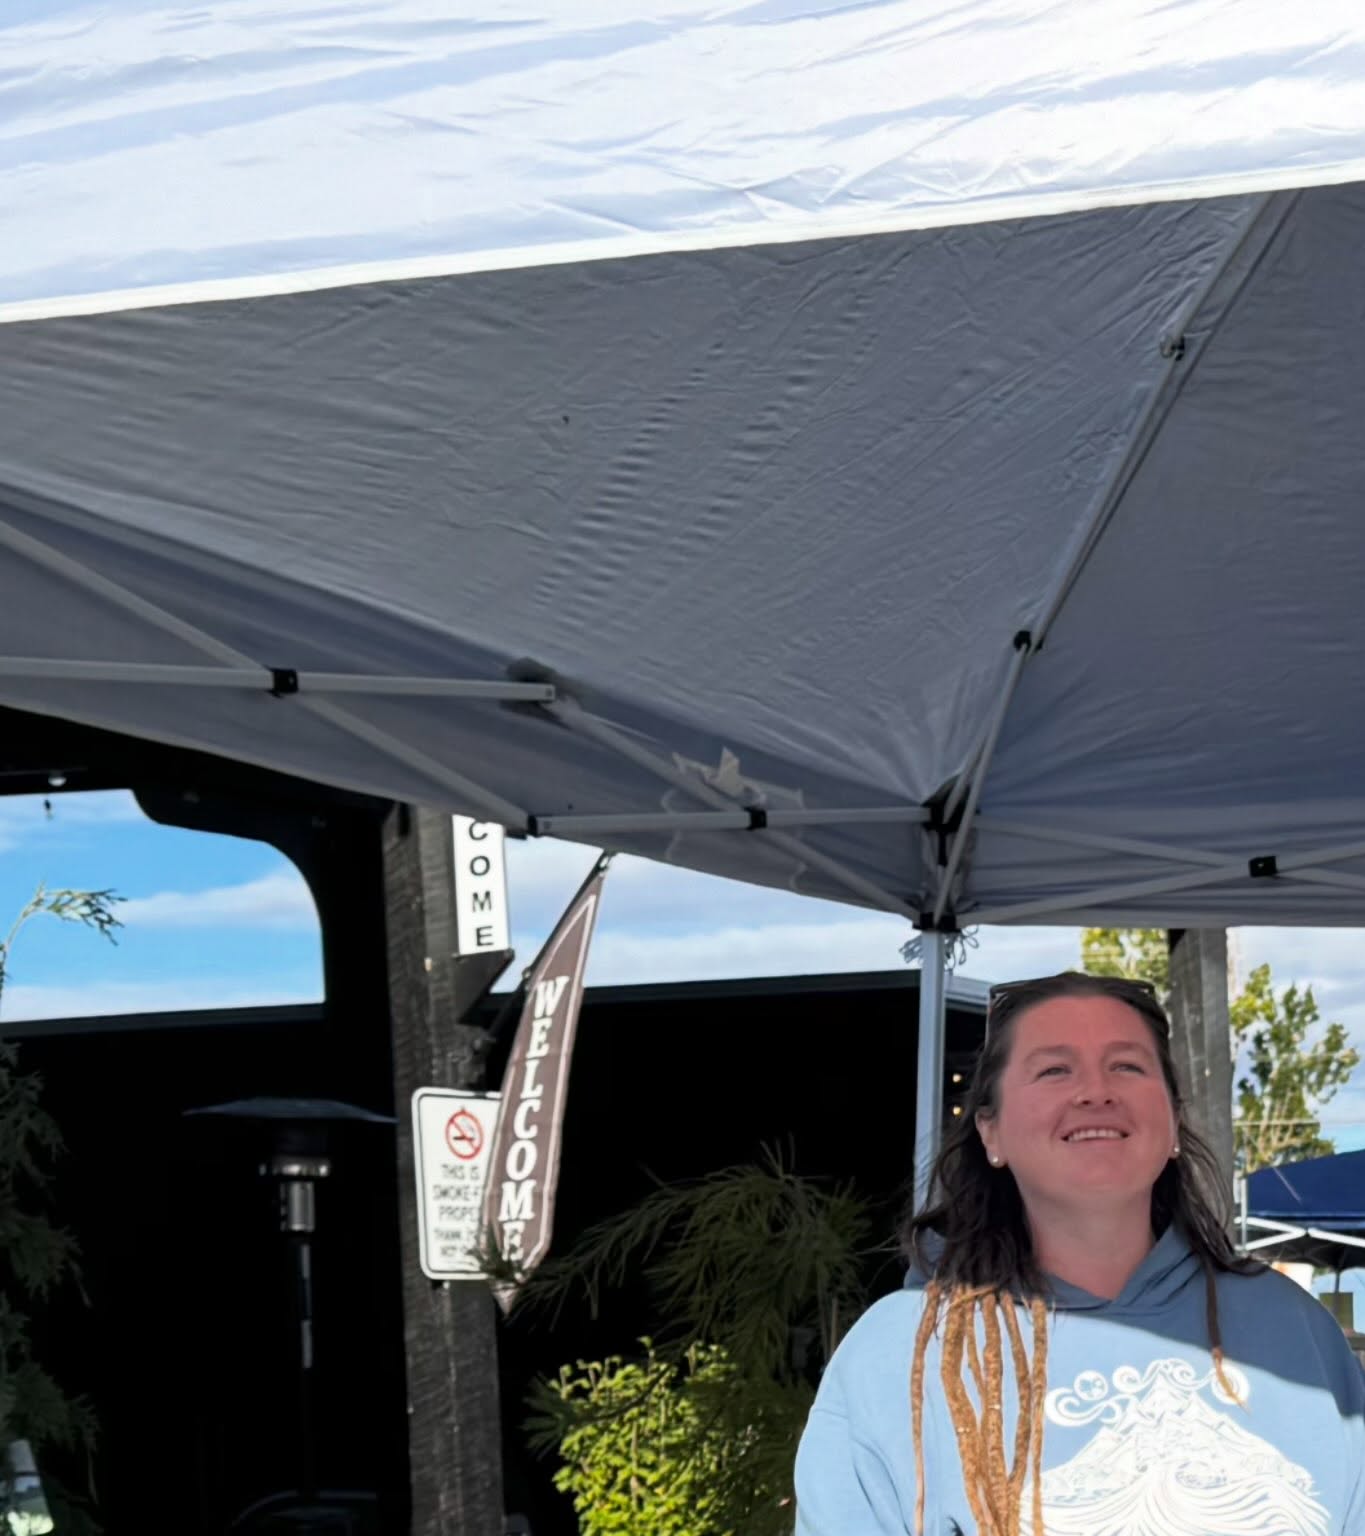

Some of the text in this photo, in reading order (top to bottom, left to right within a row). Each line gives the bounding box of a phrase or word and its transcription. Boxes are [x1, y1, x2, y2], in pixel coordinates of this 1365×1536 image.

[498, 975, 569, 1262] WELCOME
[433, 1184, 481, 1202] SMOKE-F
[439, 1205, 480, 1223] PROPE
